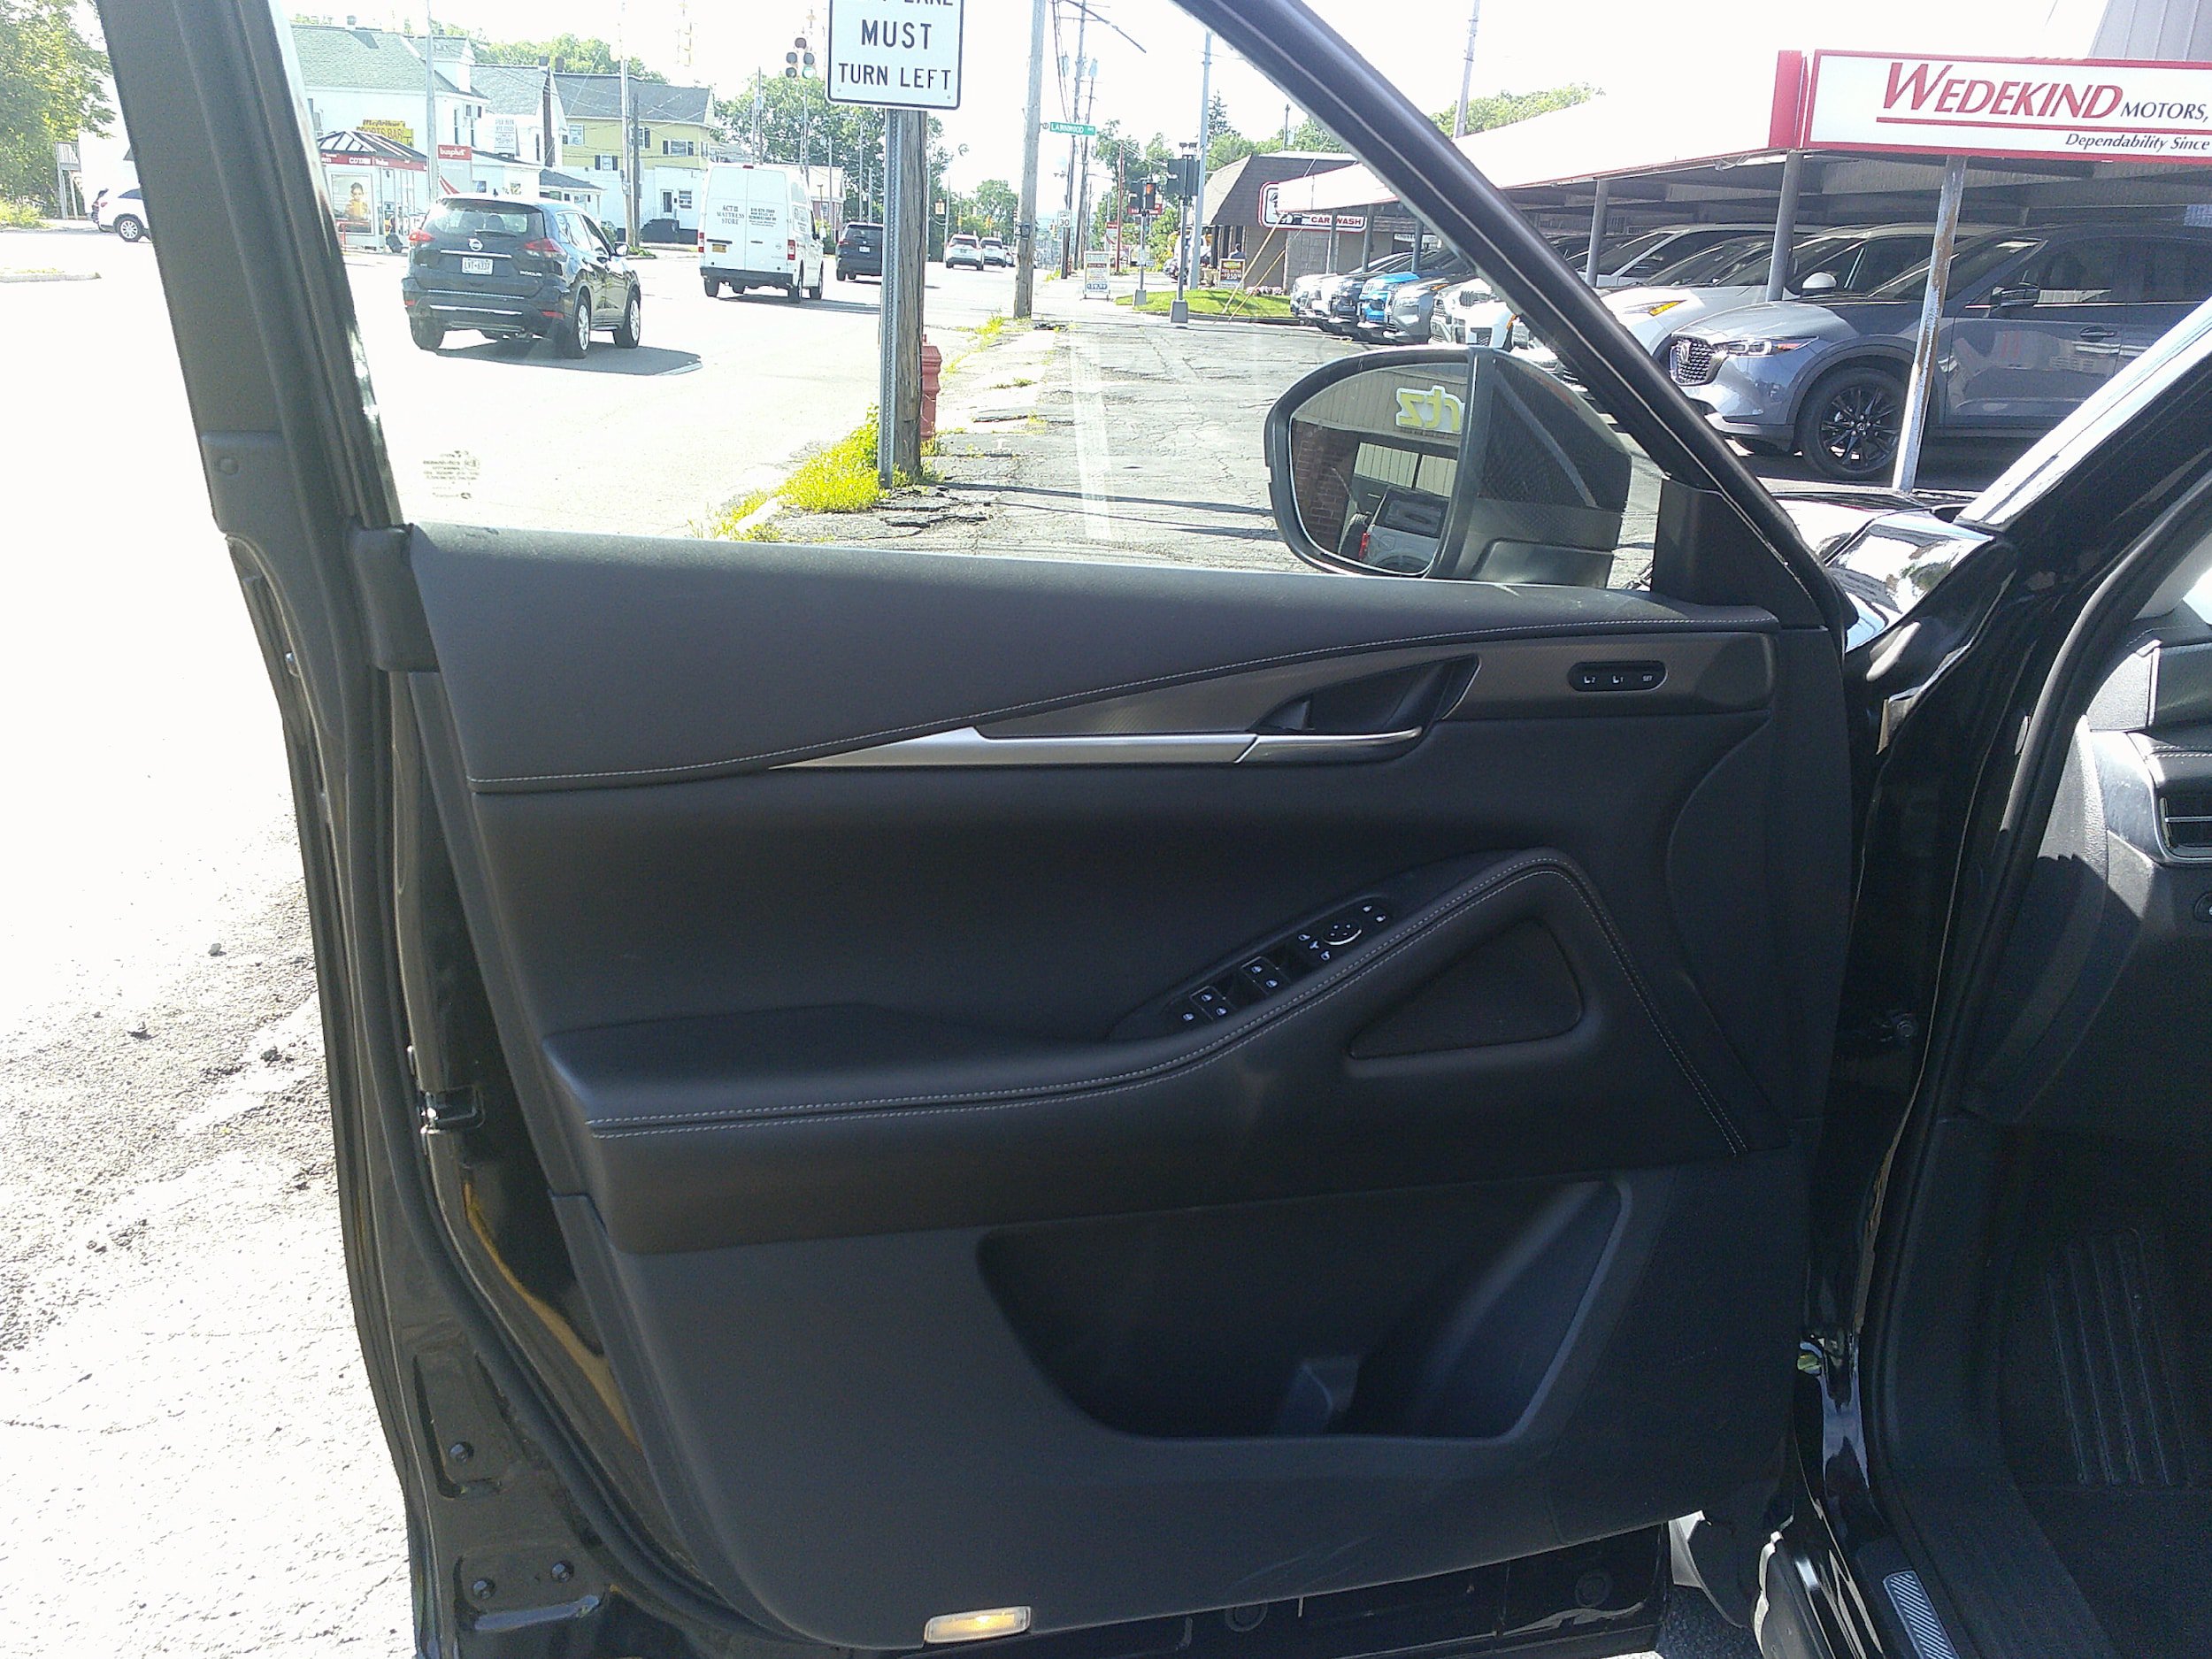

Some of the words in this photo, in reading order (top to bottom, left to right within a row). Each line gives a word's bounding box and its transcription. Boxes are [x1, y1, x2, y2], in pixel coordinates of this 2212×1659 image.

[861, 19, 932, 50] MUST
[838, 62, 888, 86] TURN
[900, 66, 951, 90] LEFT
[1883, 61, 2124, 119] WEDEKIND
[2120, 102, 2209, 123] MOTORS,
[2064, 132, 2169, 156] Dependability
[2172, 136, 2211, 151] Since
